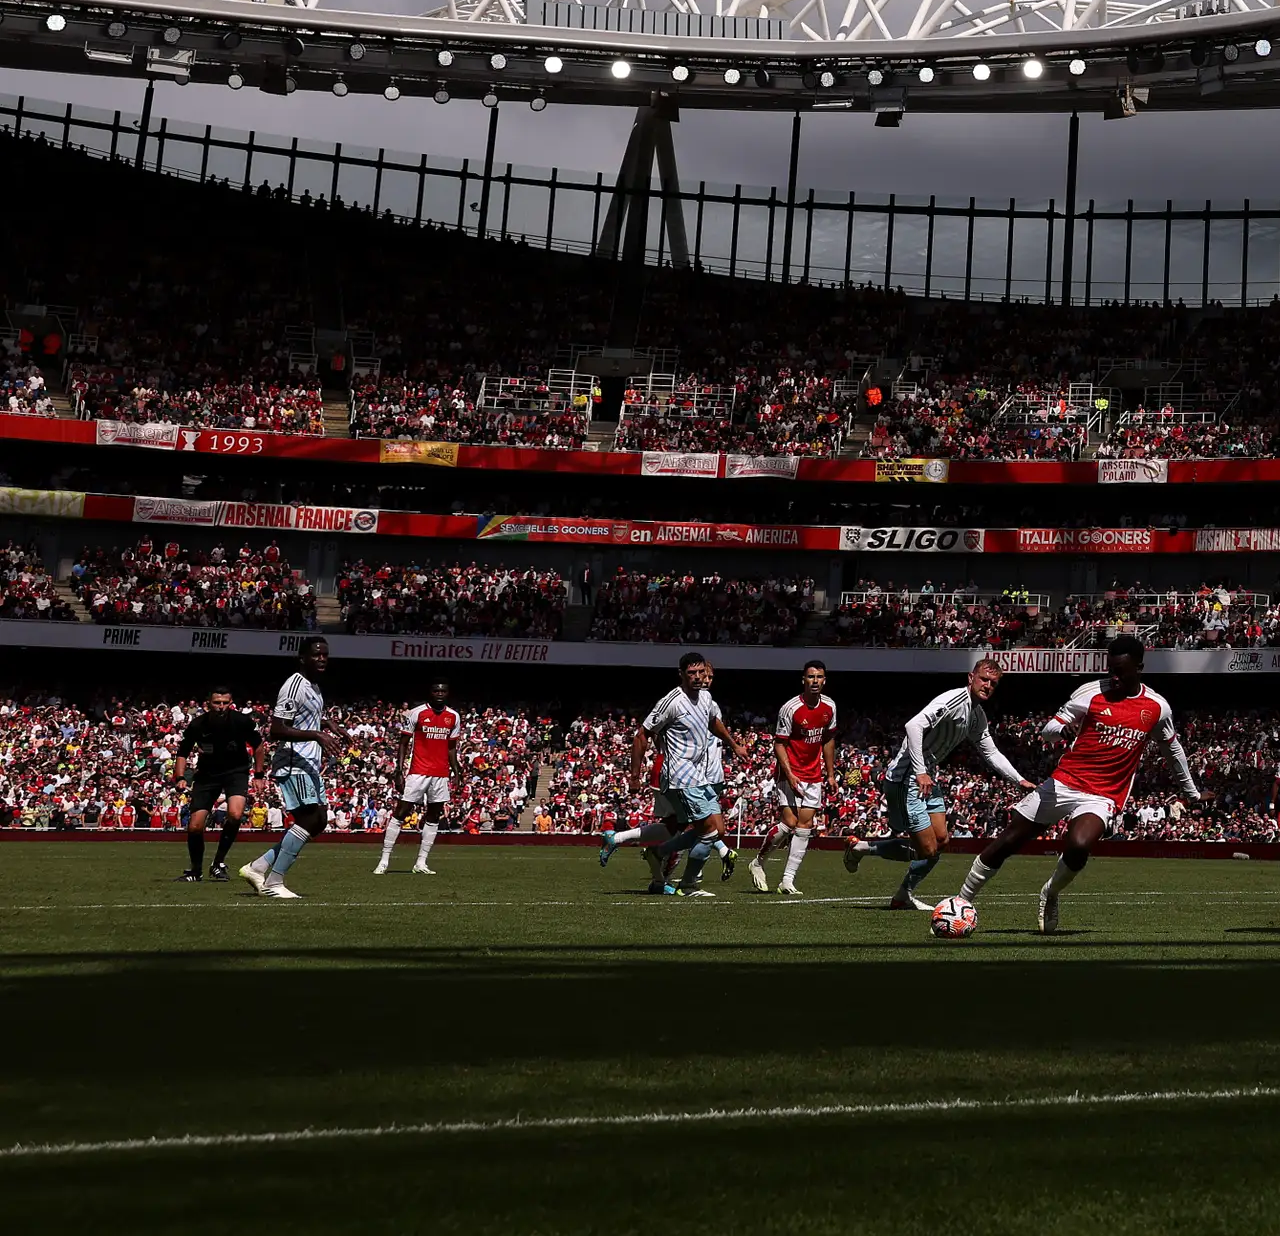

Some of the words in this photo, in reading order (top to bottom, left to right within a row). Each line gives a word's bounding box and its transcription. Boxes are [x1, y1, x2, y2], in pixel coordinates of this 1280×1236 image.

[118, 423, 177, 442] Arsenal
[209, 434, 264, 453] 1993
[661, 454, 717, 469] Arsenal
[744, 456, 798, 471] Arsenal
[1101, 461, 1139, 471] ARSENAL
[1102, 471, 1137, 481] POLAND
[154, 500, 214, 518] Arsenal
[224, 504, 293, 530] ARSENAL
[294, 508, 352, 532] FRANCE
[499, 523, 559, 533] SEYCHELLES
[561, 525, 609, 536] GOONERS
[656, 526, 712, 543] ARSENAL
[745, 528, 799, 545] AMERICA
[1019, 530, 1075, 545] ITALIAN
[867, 529, 959, 550] SLIGO
[1195, 530, 1236, 552] ARSENAL
[103, 628, 140, 646] PRIME
[192, 631, 227, 649] PRIME
[391, 639, 473, 660] Emirates
[481, 643, 502, 660] FLY
[504, 643, 549, 661] BETTER
[983, 652, 1109, 672] ARSENALDIRECT.CO
[421, 725, 451, 735] Emirates
[1094, 721, 1148, 742] Emirates
